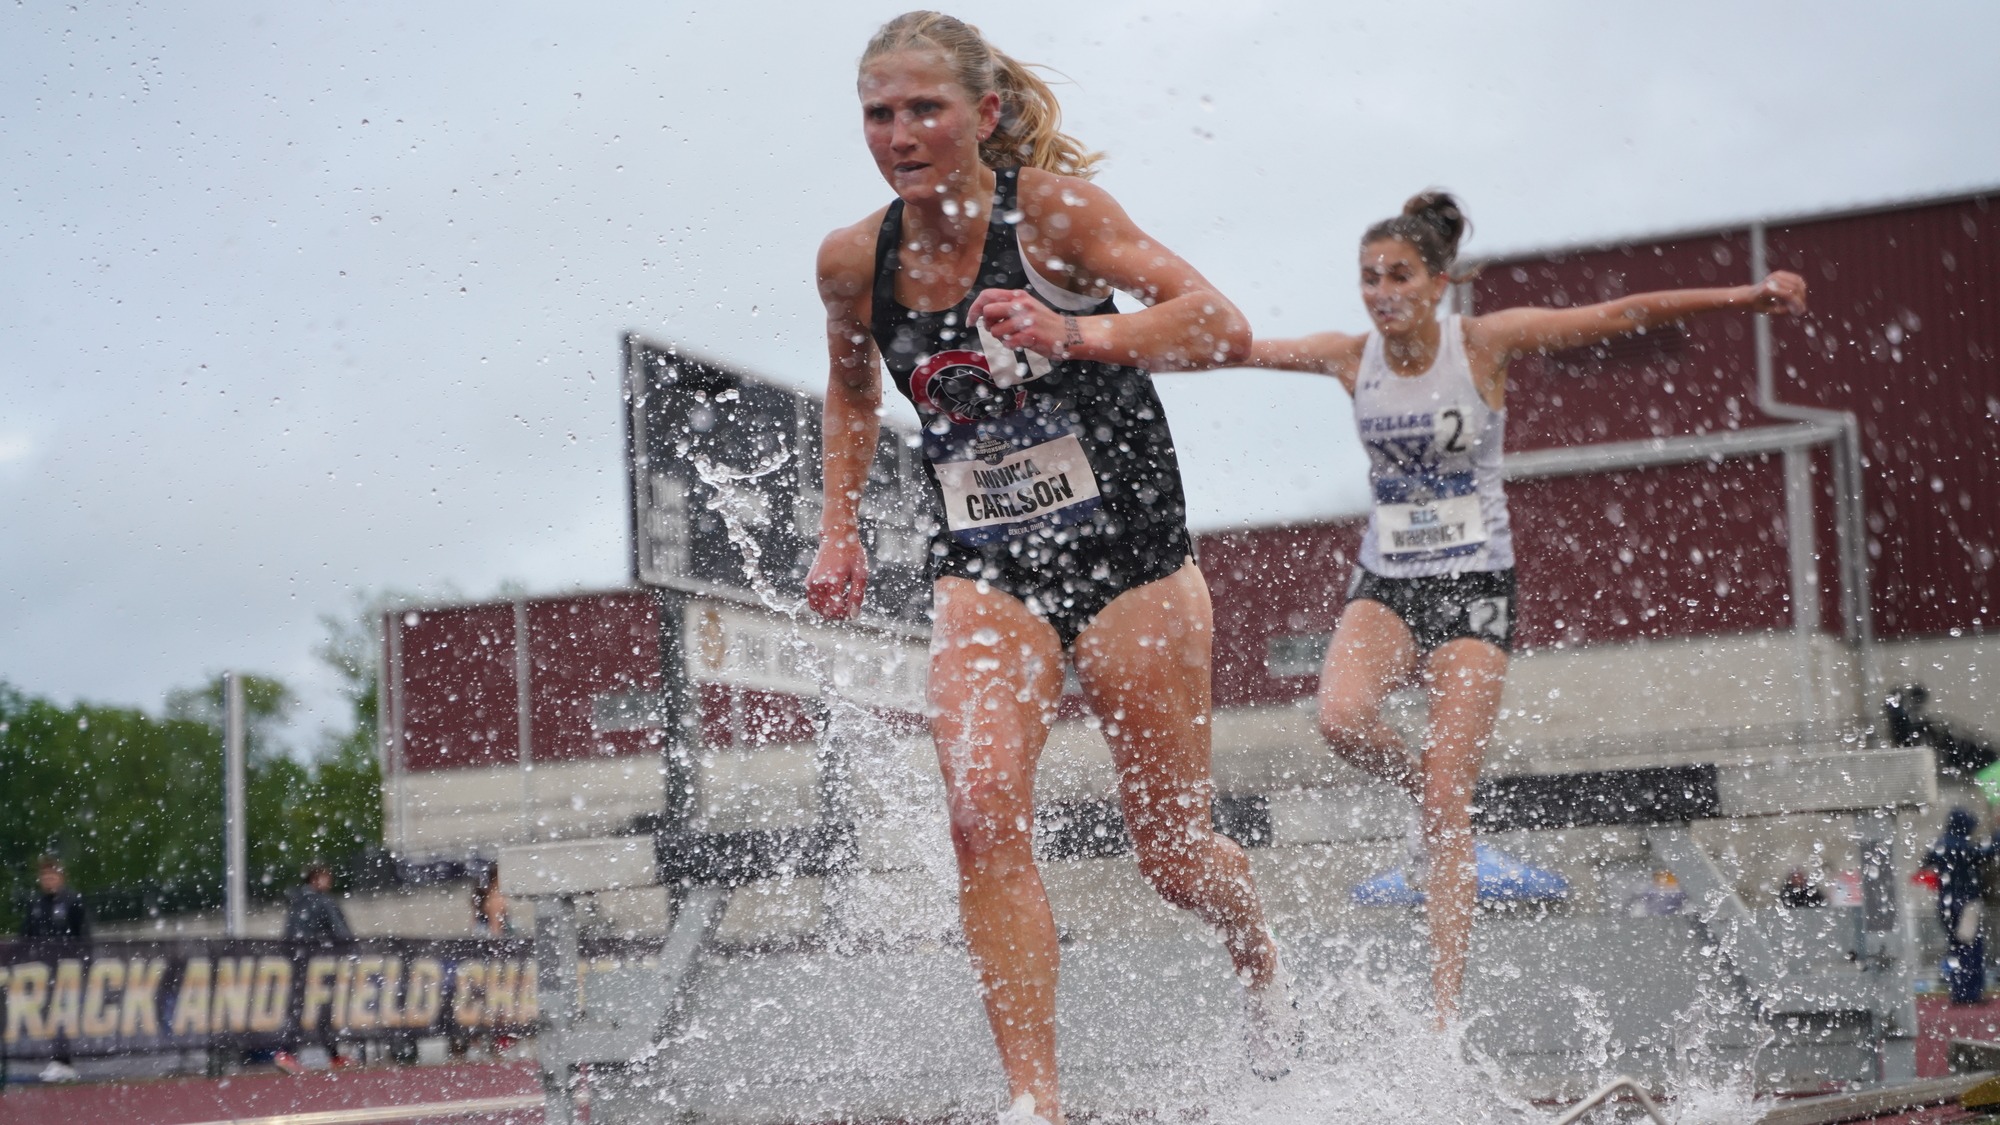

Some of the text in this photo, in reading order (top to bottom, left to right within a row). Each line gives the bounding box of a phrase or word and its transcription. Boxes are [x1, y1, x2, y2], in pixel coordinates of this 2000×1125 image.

[1442, 409, 1466, 453] 2
[973, 459, 1042, 489] ANNIKA
[966, 473, 1074, 522] CARLSON
[1030, 521, 1045, 531] OHIO
[172, 956, 294, 1036] AND
[300, 955, 442, 1031] FIELD
[454, 957, 539, 1027] CHA
